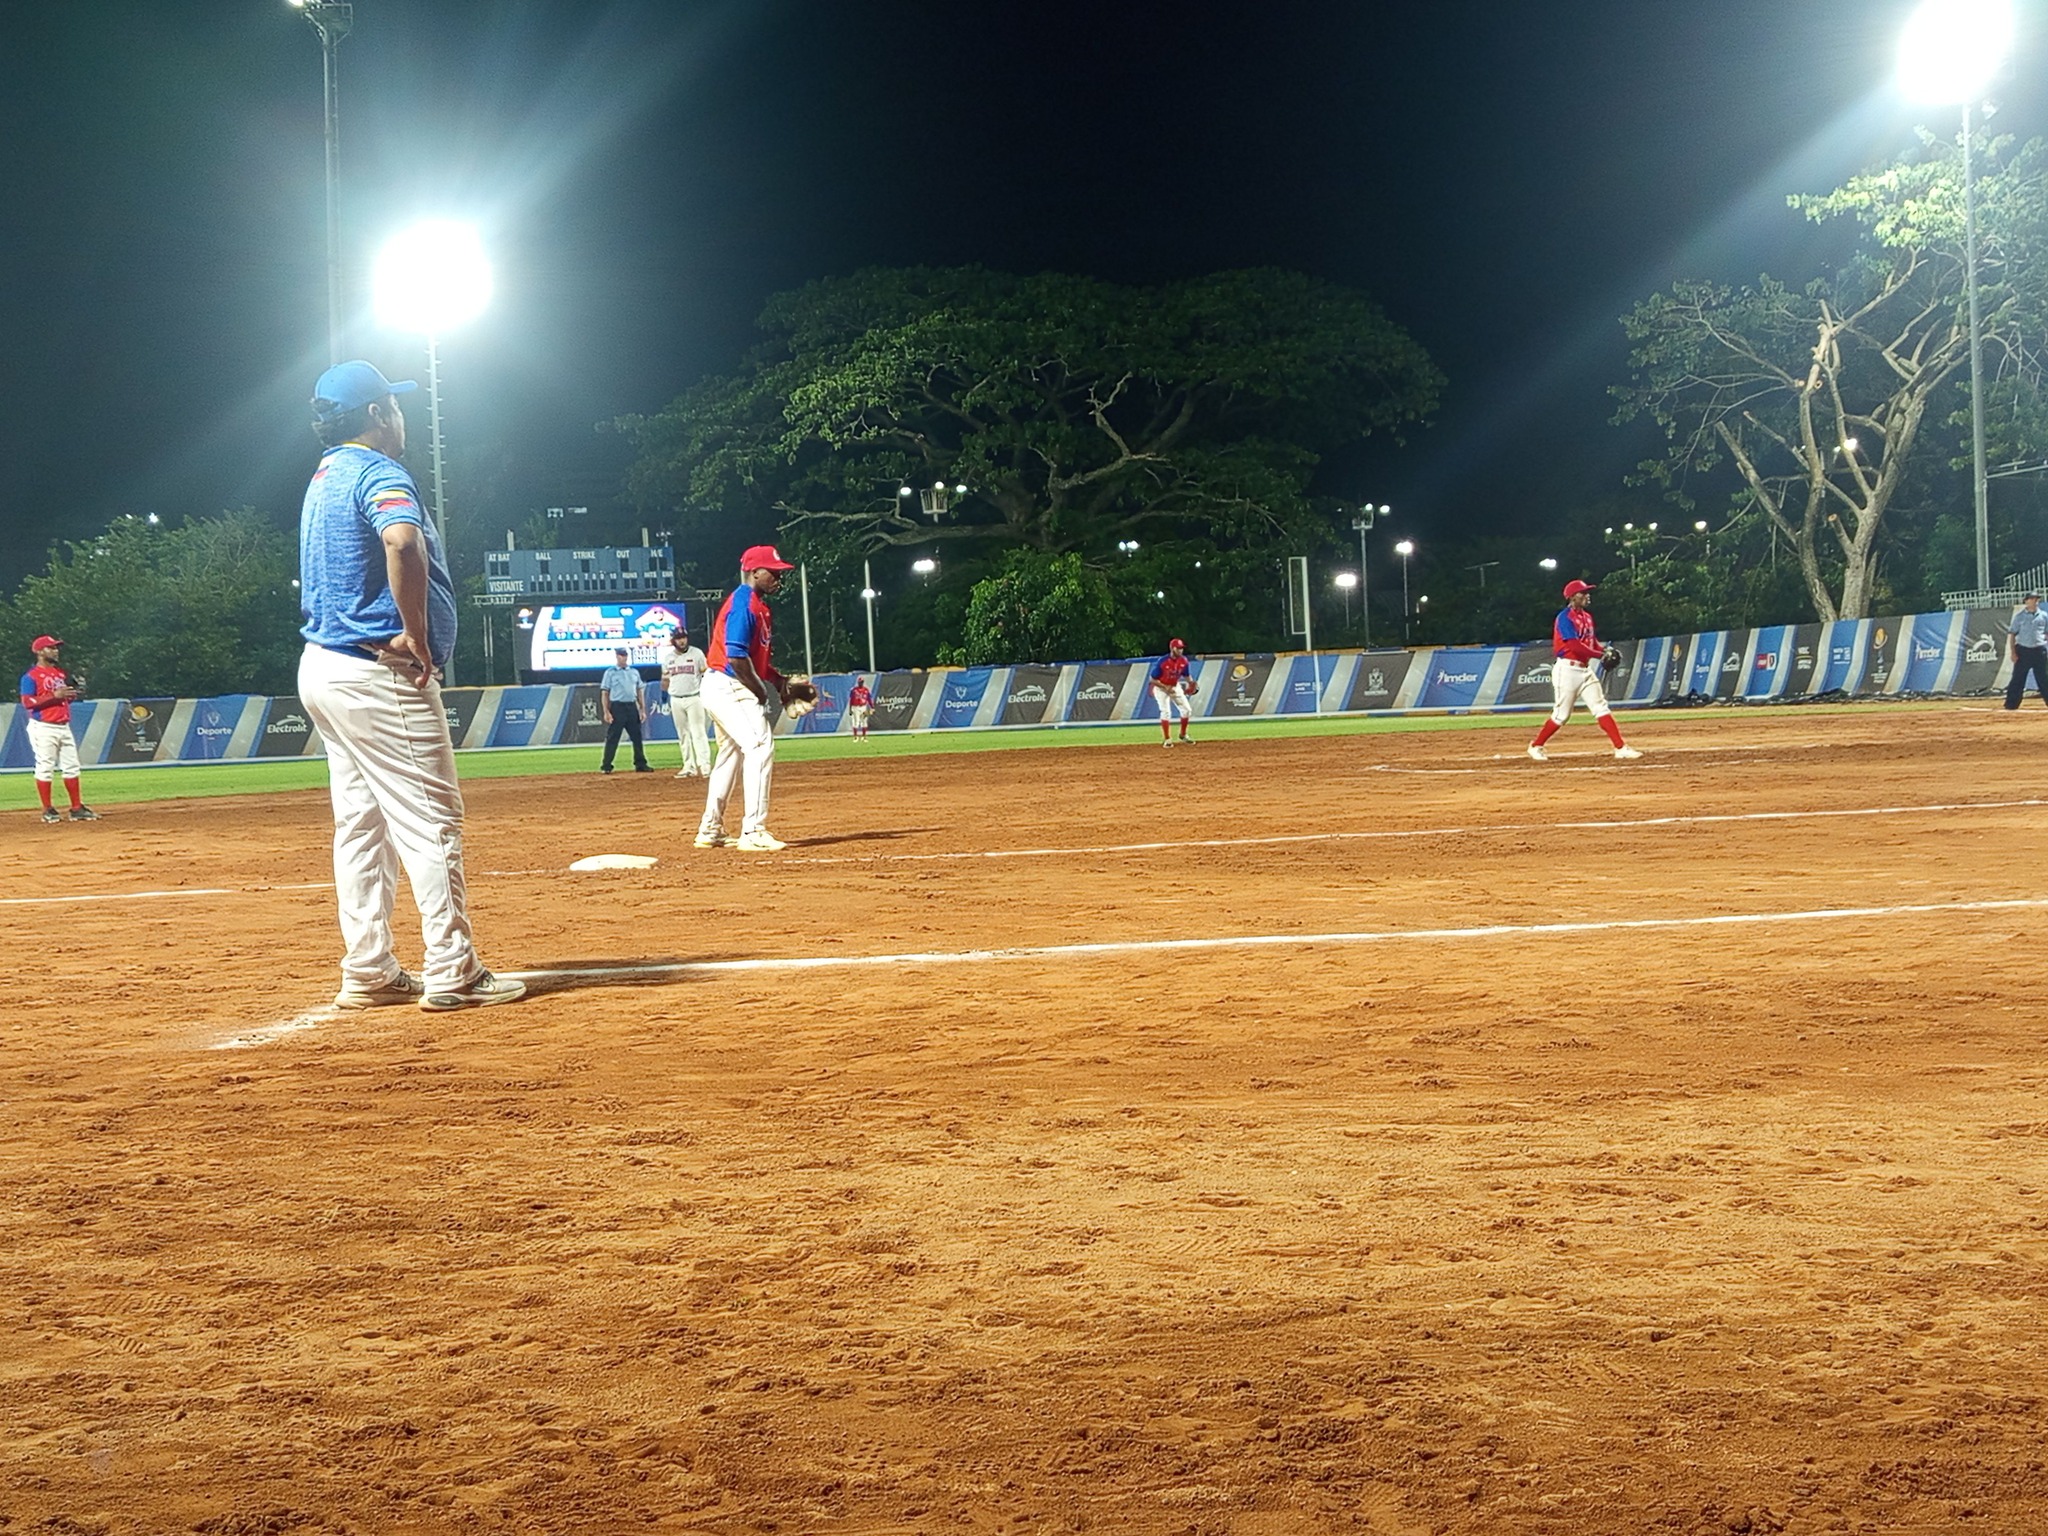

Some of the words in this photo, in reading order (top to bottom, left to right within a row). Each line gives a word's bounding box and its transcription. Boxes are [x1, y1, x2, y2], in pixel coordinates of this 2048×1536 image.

[488, 553, 496, 562] AT
[498, 553, 510, 562] BAT
[535, 552, 551, 560] BALL
[573, 551, 596, 559] STRIKE
[616, 550, 630, 558] OUT
[489, 580, 524, 592] VISITANTE
[1518, 674, 1551, 684] Electro
[1008, 693, 1046, 703] Electrolit
[1077, 689, 1115, 700] Electrolit
[945, 700, 978, 709] Deporte
[197, 727, 232, 736] Deporte
[267, 723, 307, 734] Electrolit
